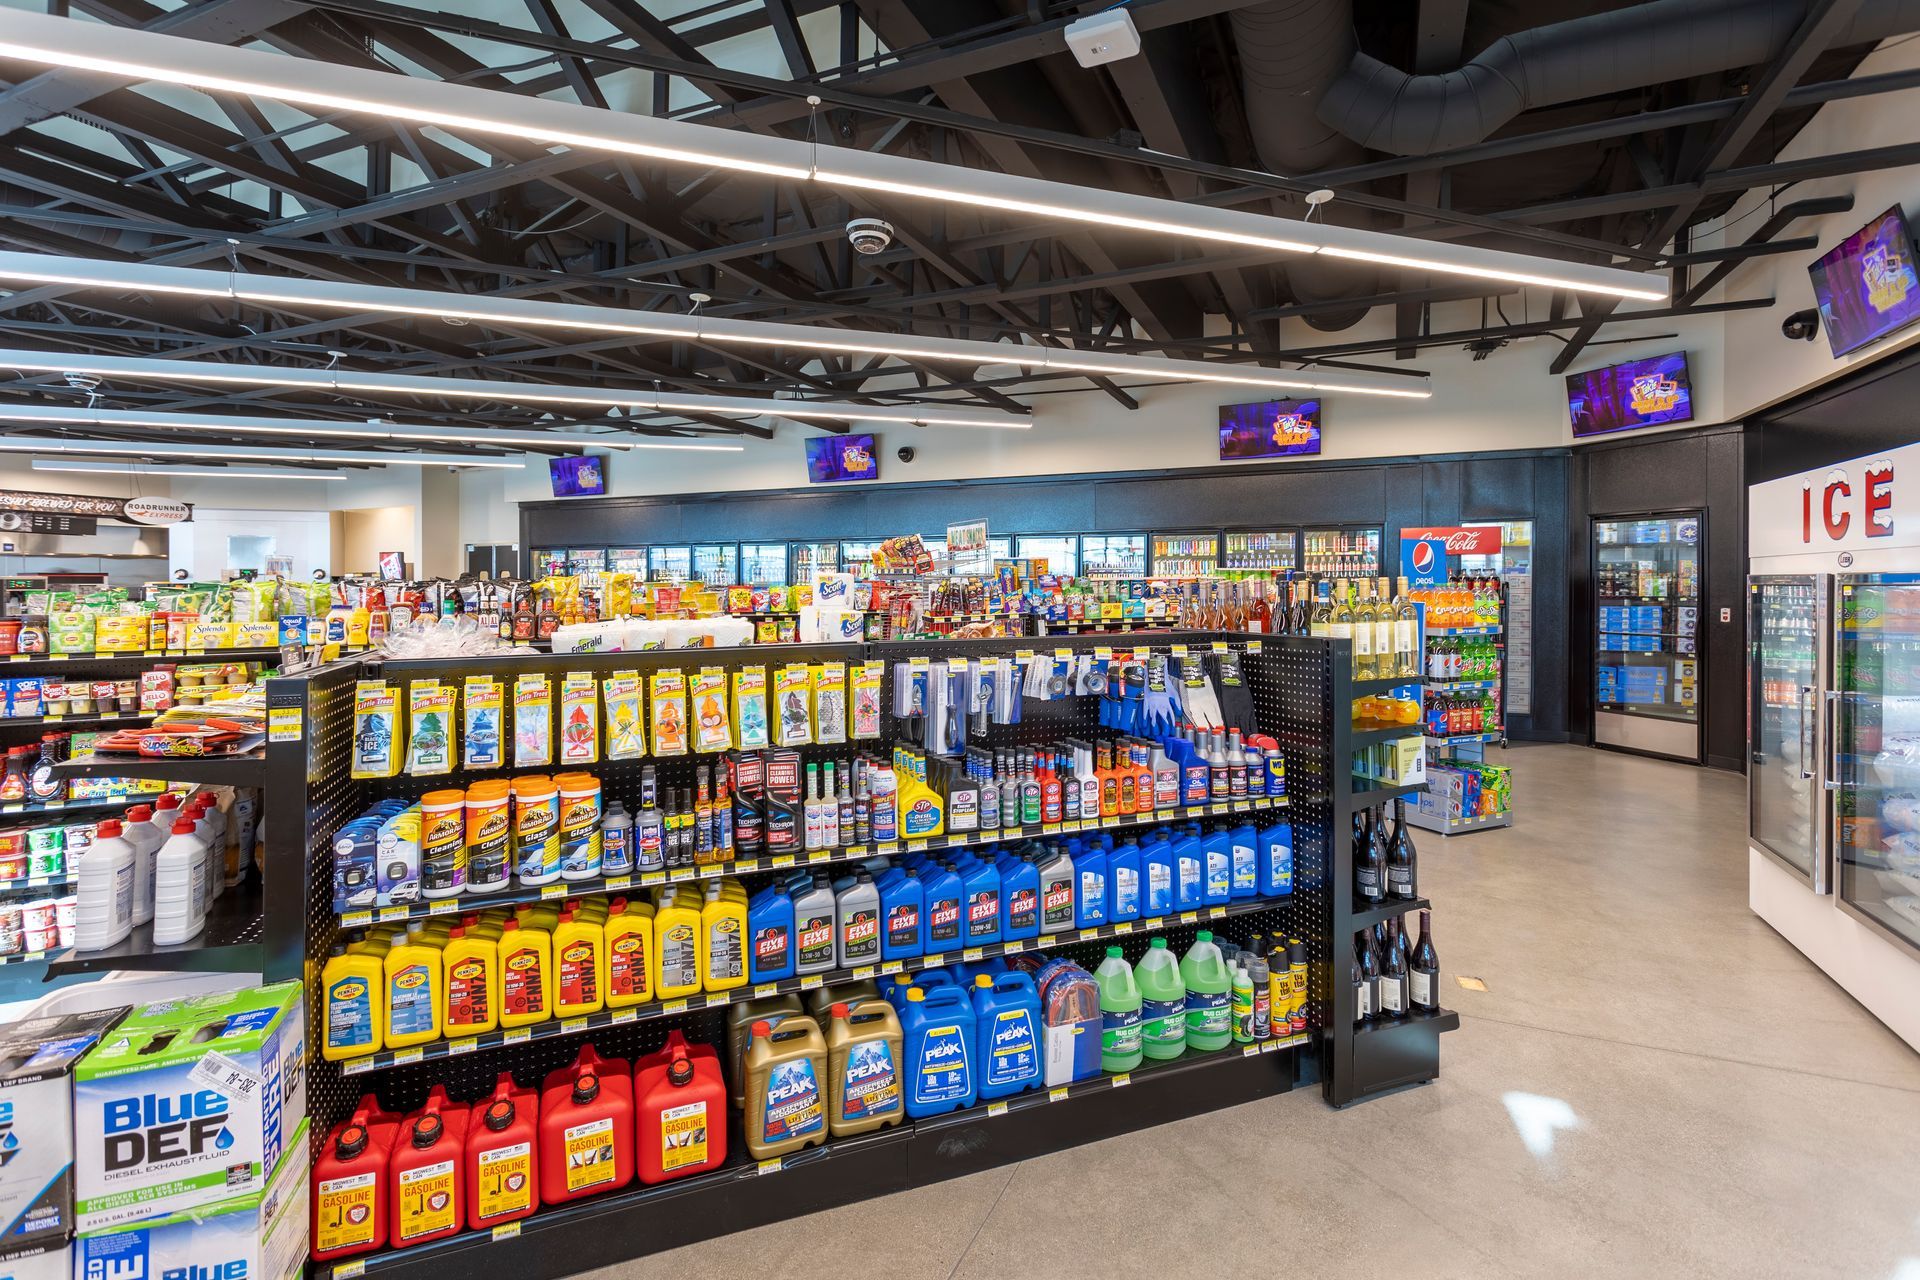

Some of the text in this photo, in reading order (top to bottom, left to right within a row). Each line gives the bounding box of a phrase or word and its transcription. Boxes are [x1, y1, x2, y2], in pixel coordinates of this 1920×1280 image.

[31, 498, 117, 512] BREWED FOR YOU
[1801, 458, 1895, 544] ICE
[127, 503, 187, 512] ROADRUNNER
[149, 511, 184, 520] EXPRESS
[1415, 577, 1434, 586] pepsi
[822, 580, 844, 595] Scott
[283, 617, 303, 627] equal
[193, 624, 226, 633] Splenda
[240, 623, 272, 633] Splenda
[571, 634, 602, 653] Emerald
[357, 697, 395, 711] Little Trees
[412, 700, 430, 710] Little
[466, 693, 500, 706] Little Trees
[142, 739, 170, 751] Super
[739, 775, 760, 783] POWER
[769, 776, 795, 784] POWER
[1162, 774, 1173, 782] STP
[1191, 771, 1202, 779] STP
[1028, 788, 1039, 796] STP
[1047, 785, 1059, 793] STP
[1067, 784, 1078, 793] STP
[914, 801, 930, 811] STP
[769, 821, 795, 829] TECHRON
[525, 830, 548, 842] Glass
[570, 825, 592, 837] Glass
[430, 838, 463, 855] Cleaning
[1014, 897, 1034, 907] FIVE
[1048, 891, 1070, 902] FIVE
[971, 902, 997, 914] FIVE
[1013, 904, 1033, 913] STAR
[1047, 898, 1069, 908] STAR
[935, 907, 957, 918] FIVE
[971, 910, 996, 919] STAR
[893, 914, 915, 925] FIVE
[935, 915, 956, 924] STAR
[849, 922, 875, 935] FIVE
[892, 921, 914, 930] STAR
[803, 928, 830, 941] FIVE
[848, 928, 874, 940] STAR
[617, 941, 636, 950] PENNZOIL
[760, 936, 785, 949] FIVE
[803, 935, 829, 947] STAR
[759, 943, 784, 954] STAR
[567, 950, 587, 960] PENNZOIL
[511, 958, 532, 968] PENNZOIL
[456, 967, 478, 976] PENNZOIL
[399, 976, 421, 986] PENNZOIL
[337, 986, 360, 996] PENNZOIL
[995, 1025, 1030, 1045] PEAK
[925, 1042, 962, 1062] PEAK
[284, 1039, 303, 1081] Blue
[94, 1066, 140, 1078] GUARANTEED
[161, 1054, 198, 1066] AMERICA'S
[846, 1058, 893, 1084] PEAK
[4, 1075, 42, 1087] DEF BRAND
[767, 1078, 815, 1105] PEAK
[103, 1089, 229, 1135] Blue
[269, 1051, 281, 1173] PURE
[671, 1106, 691, 1114] MIDWEST
[576, 1124, 596, 1132] MIDWEST
[665, 1117, 703, 1134] GASOLINE
[103, 1113, 230, 1172] DEF
[569, 1134, 610, 1153] GASOLINE
[491, 1148, 512, 1156] MIDWEST
[104, 1150, 230, 1181] DIESEL EXHAUST FLUID
[483, 1159, 526, 1177] GASOLINE
[412, 1167, 435, 1176] MIDWEST
[332, 1178, 355, 1186] MIDWEST
[404, 1177, 450, 1198] GASOLINE
[86, 1181, 183, 1206] APPROVED FOR USE IN
[86, 1203, 103, 1212] ALL
[105, 1198, 134, 1209] DIESEL
[157, 1184, 197, 1198] SYSTEMS
[323, 1190, 371, 1209] GASOLINE
[20, 1247, 45, 1258] BRAND
